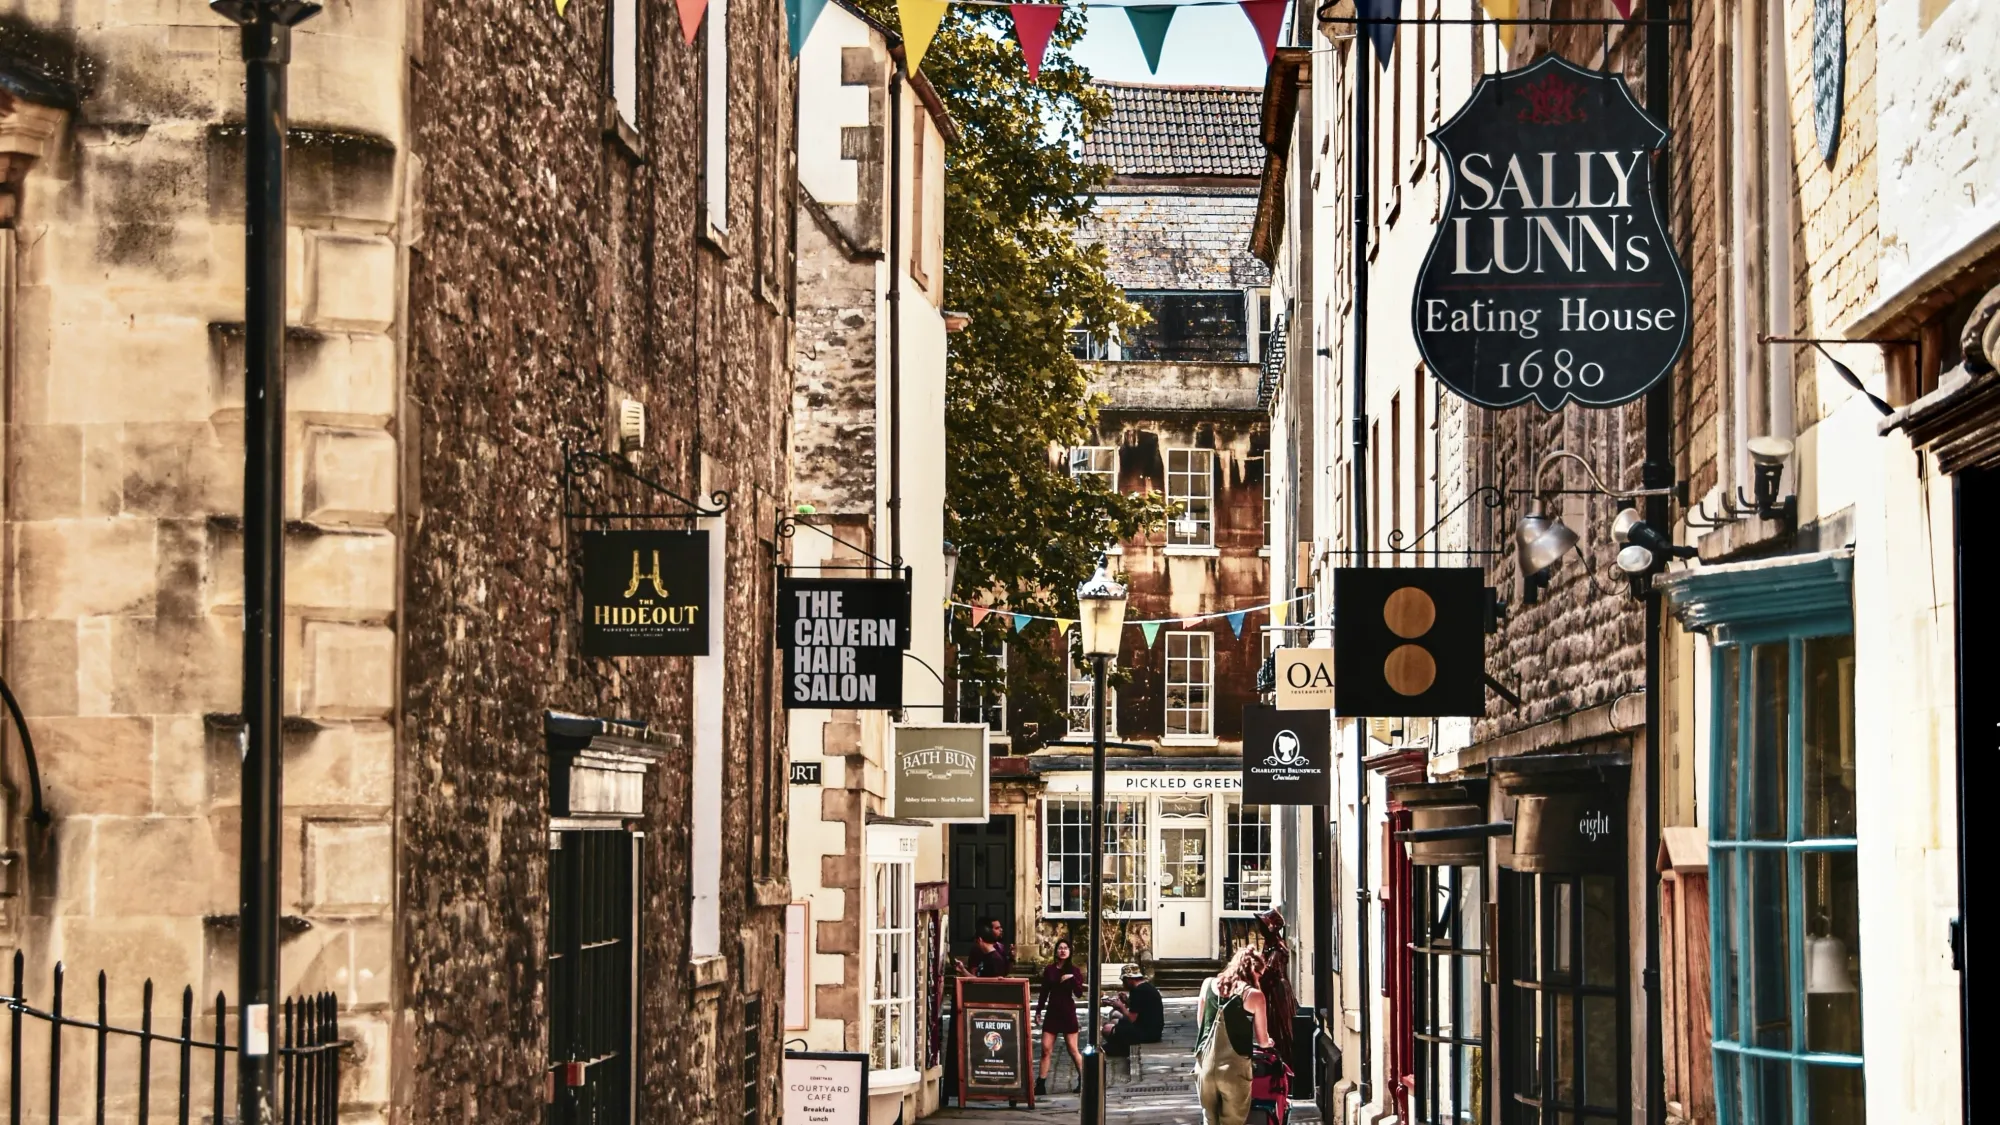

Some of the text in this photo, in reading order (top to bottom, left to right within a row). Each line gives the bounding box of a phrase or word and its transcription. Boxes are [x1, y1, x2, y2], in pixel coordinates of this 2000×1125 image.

[1460, 151, 1643, 210] SALLY
[1425, 298, 1676, 339] Eating House
[1498, 349, 1604, 388] 1680
[595, 605, 699, 625] HIDEOUT
[795, 590, 843, 618] THE
[794, 618, 896, 646] CAVERN
[794, 646, 856, 674] HAIR
[794, 673, 876, 702] SALON
[1287, 662, 1334, 688] OA
[903, 751, 977, 771] BATH BUN
[1251, 766, 1321, 774] CHARLOTTE BRUNSWICK
[1126, 778, 1242, 788] PICKLED GREEN
[1579, 810, 1610, 841] eight
[996, 1022, 1011, 1030] OPEN
[790, 1084, 850, 1093] COURTYARD
